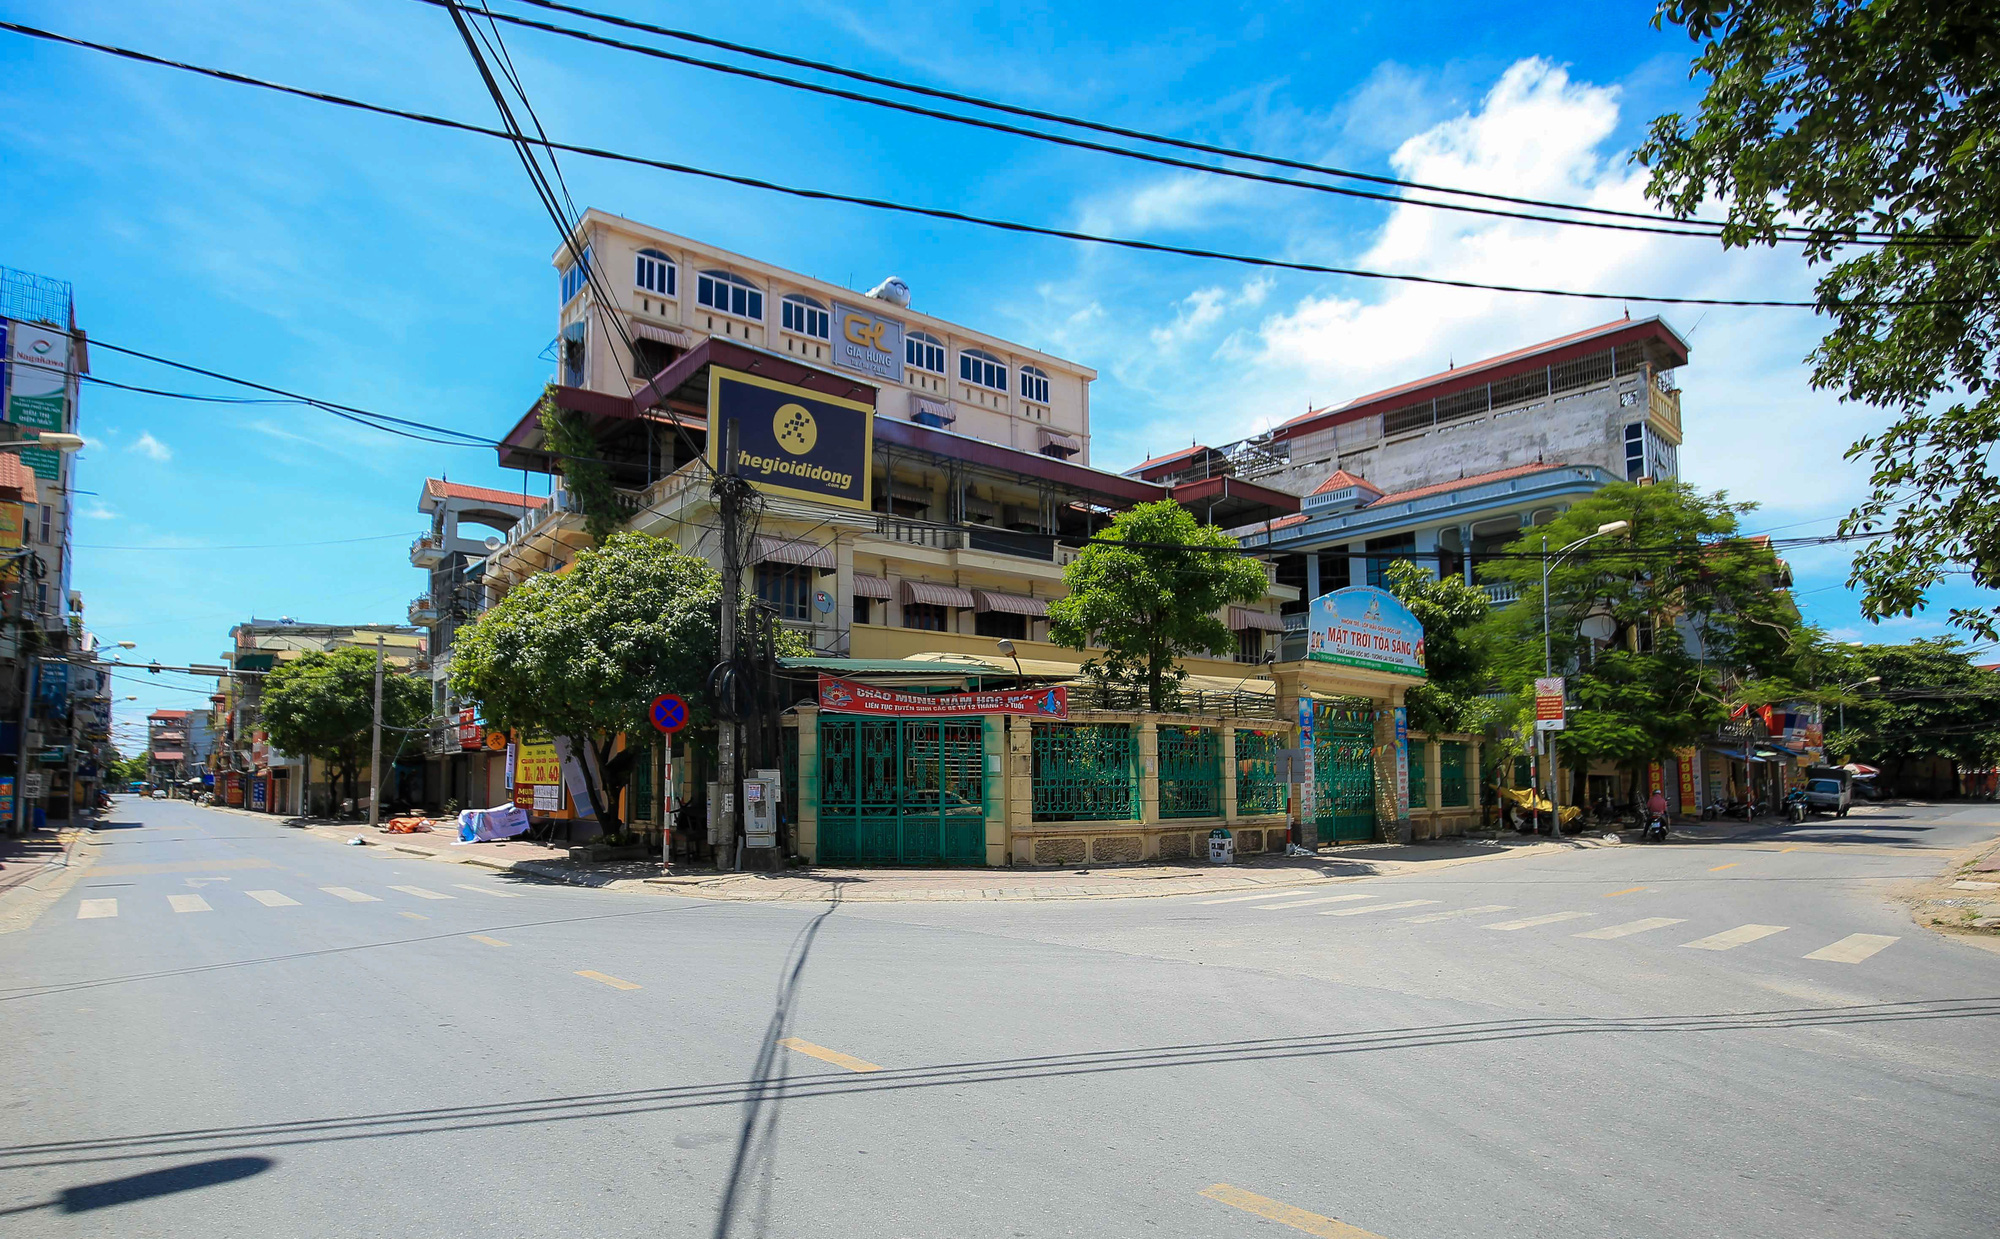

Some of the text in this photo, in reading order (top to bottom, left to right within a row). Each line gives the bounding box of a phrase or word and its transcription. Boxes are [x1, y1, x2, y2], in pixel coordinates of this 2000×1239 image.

[846, 344, 892, 367] GIA HUNG
[737, 449, 853, 490] hegioididong
[1327, 625, 1411, 655] MẶT TRỜI TỎA SÁNG
[881, 703, 893, 711] TỤC
[940, 694, 972, 706] NĂM
